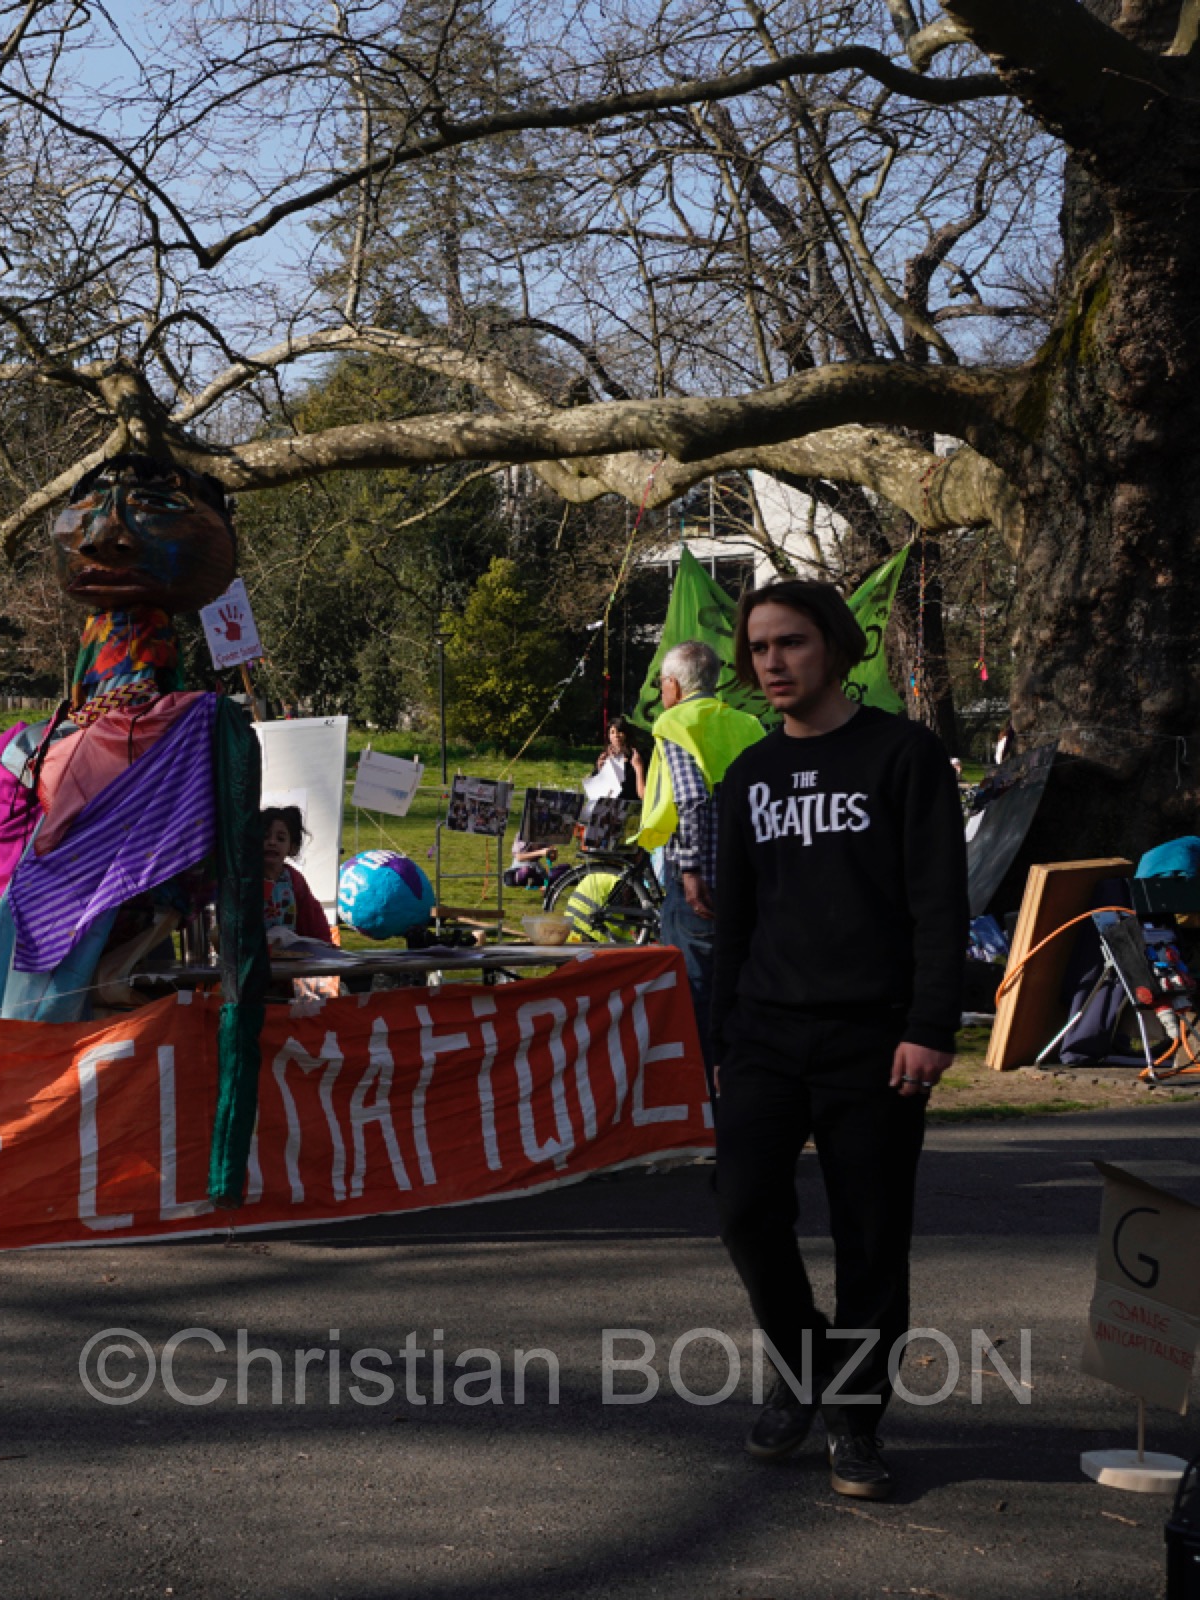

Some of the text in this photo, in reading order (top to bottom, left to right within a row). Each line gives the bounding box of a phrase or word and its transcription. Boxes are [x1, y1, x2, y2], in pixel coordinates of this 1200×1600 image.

[791, 770, 818, 788] THE
[748, 782, 871, 846] BEATLES
[1113, 1207, 1160, 1288] G
